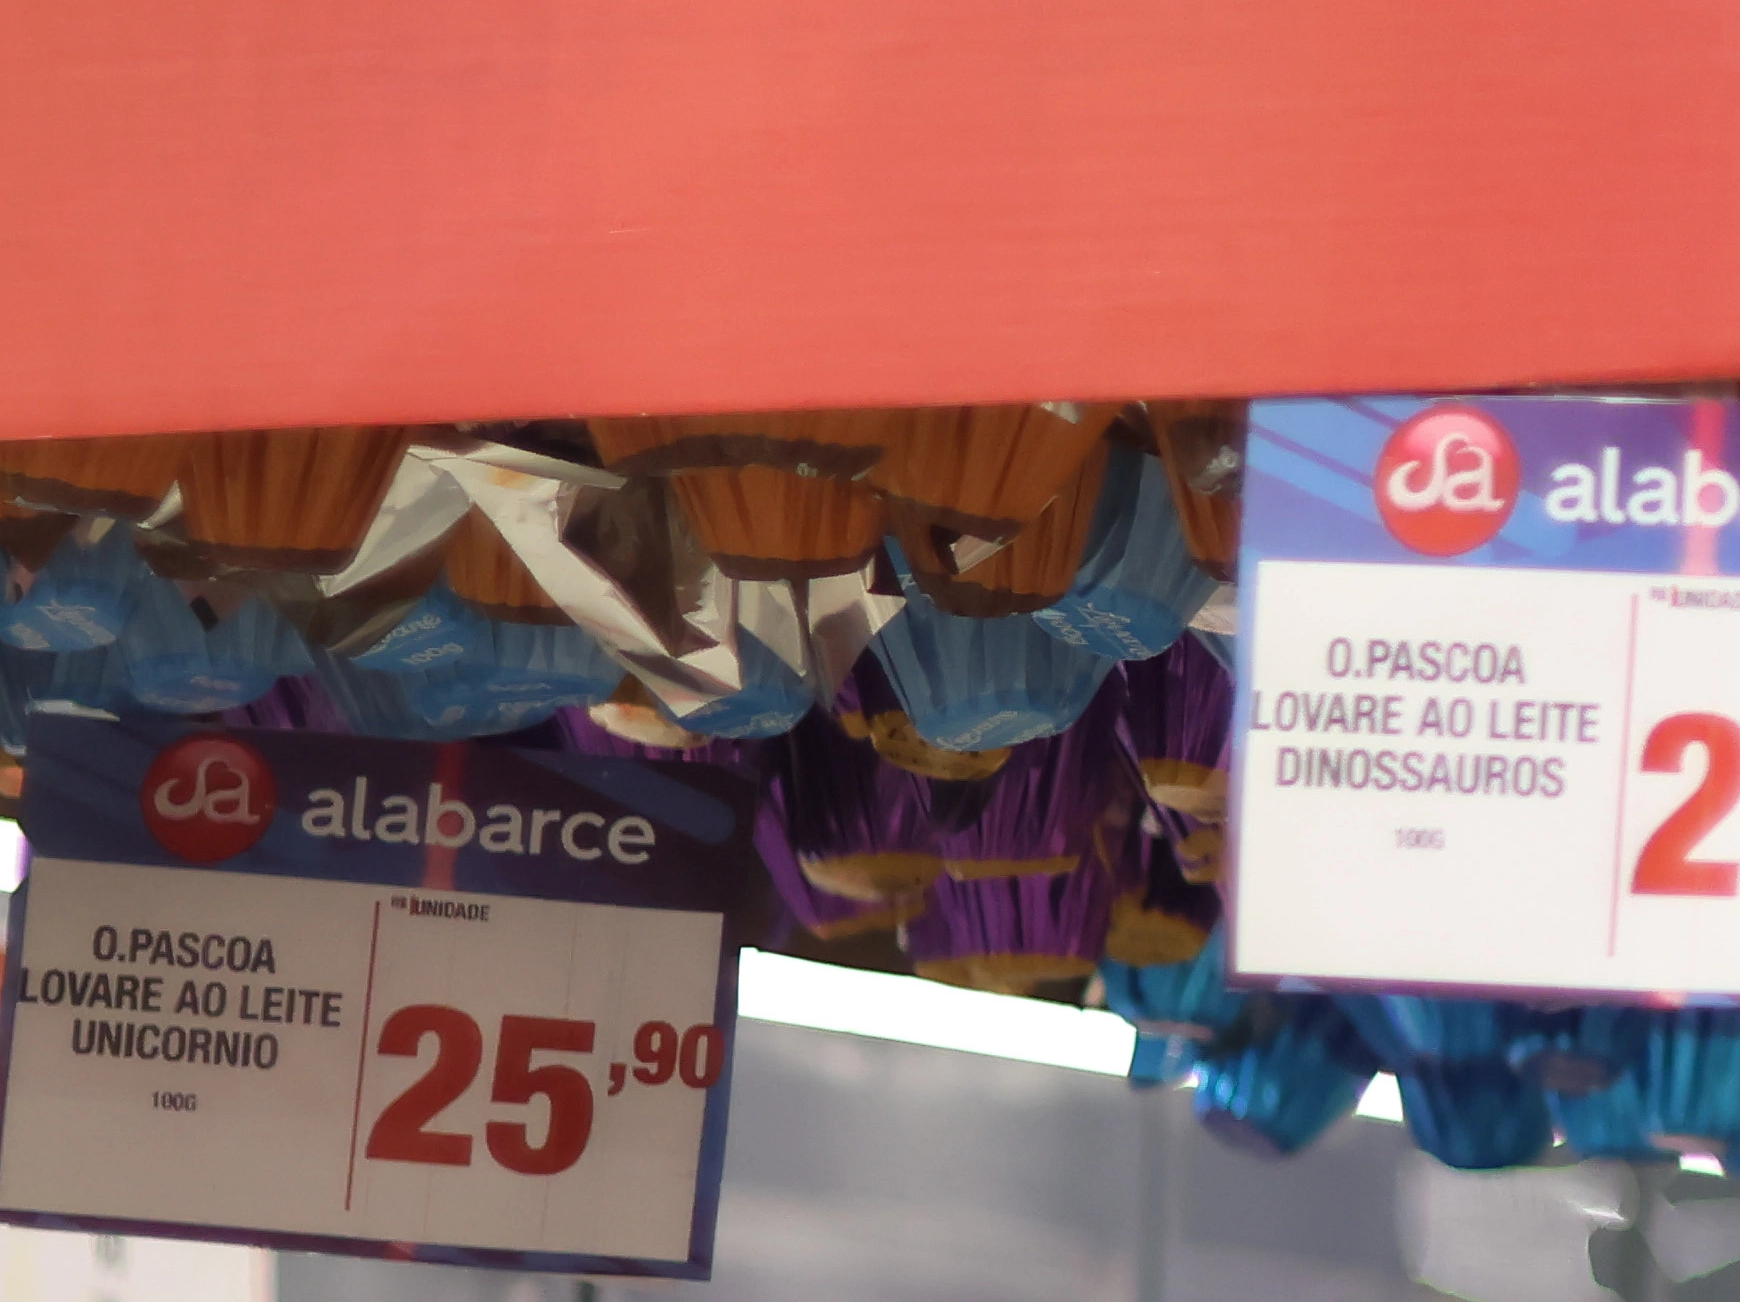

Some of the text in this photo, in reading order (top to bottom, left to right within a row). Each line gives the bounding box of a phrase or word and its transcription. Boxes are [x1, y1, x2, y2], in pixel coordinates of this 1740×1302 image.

[1327, 637, 1525, 684] O.PASCOA
[1251, 691, 1599, 744] LOVARE AO LEITE
[1275, 746, 1565, 797] DINOSSAUROS
[301, 777, 656, 864] alabarce
[92, 926, 276, 973] O.PASCOA
[18, 967, 343, 1028] LOVARE AO LEITE
[72, 1019, 278, 1069] UNICORNIO
